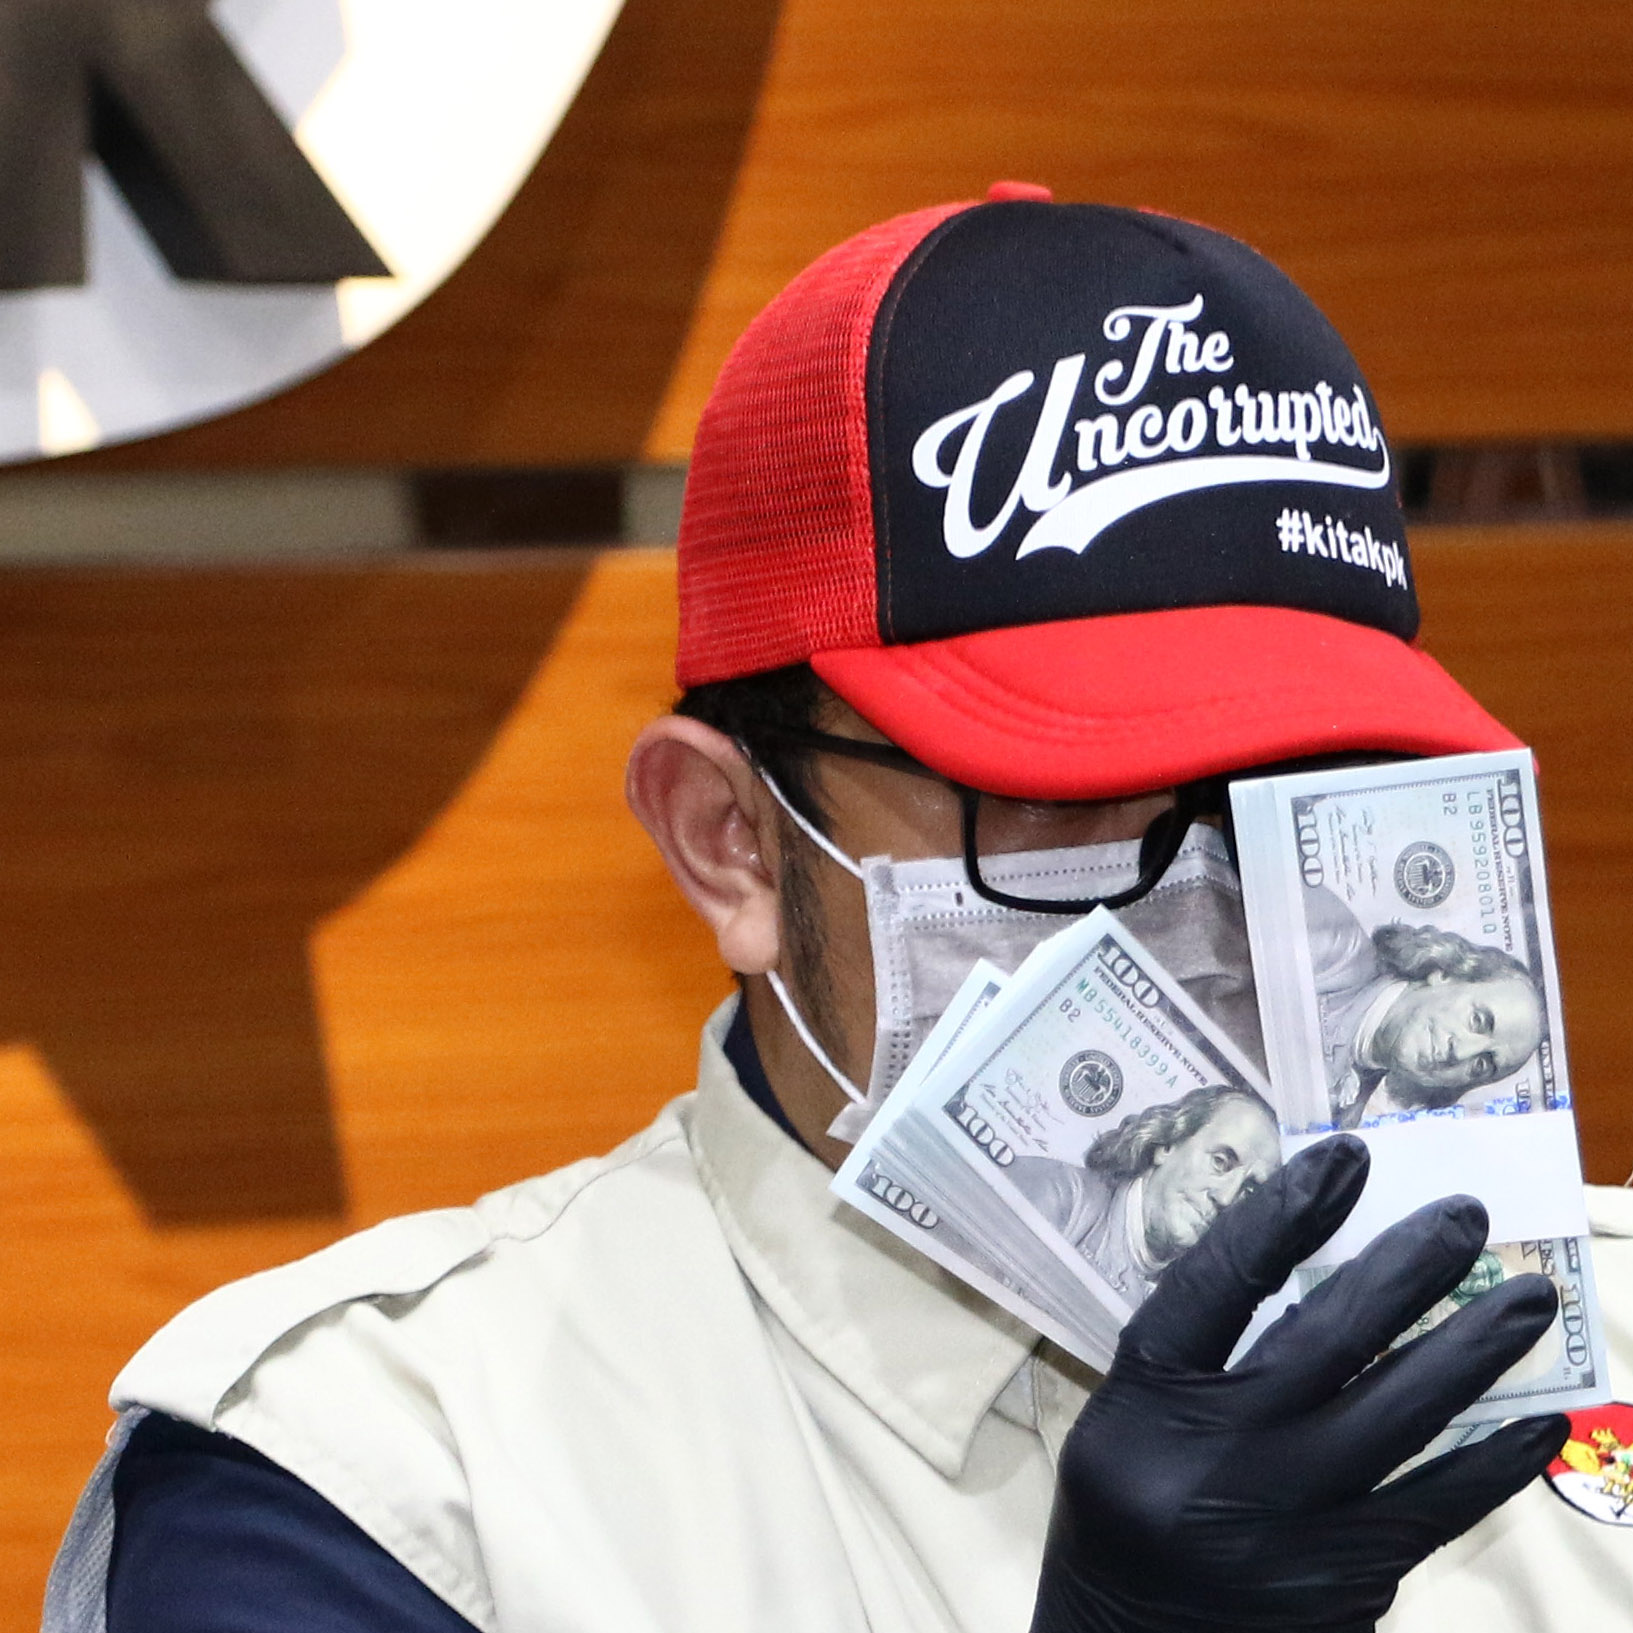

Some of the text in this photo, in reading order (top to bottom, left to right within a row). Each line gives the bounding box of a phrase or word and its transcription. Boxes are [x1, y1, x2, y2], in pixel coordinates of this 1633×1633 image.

[1094, 293, 1234, 406] The
[912, 352, 1389, 560] Uncorrupted
[1442, 792, 1457, 816] B2
[1497, 778, 1527, 858] 100
[1297, 809, 1324, 888] 100
[1059, 998, 1081, 1022] B2
[1097, 946, 1160, 1008] 100
[955, 1101, 1016, 1167] 100
[870, 1173, 940, 1229] 100
[1561, 1284, 1588, 1366] 100
